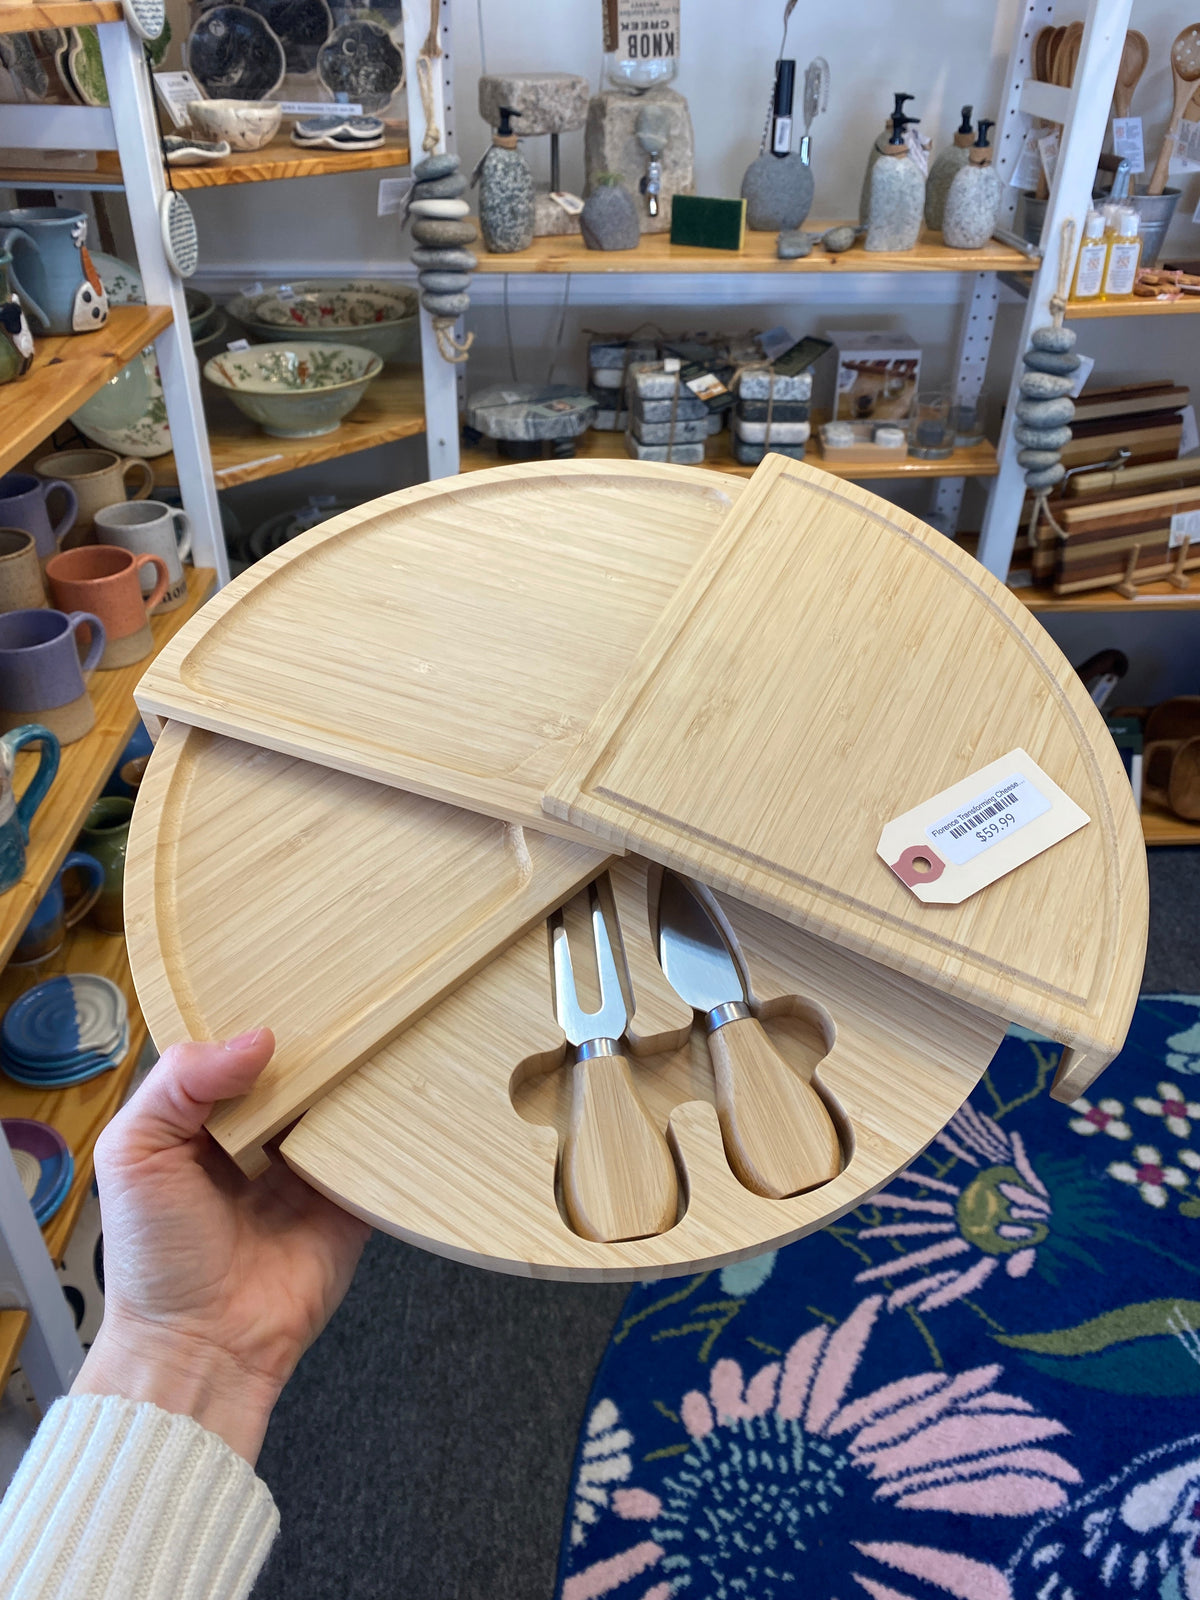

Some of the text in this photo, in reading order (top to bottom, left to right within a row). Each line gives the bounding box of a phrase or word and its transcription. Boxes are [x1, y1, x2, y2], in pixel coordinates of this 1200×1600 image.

[621, 20, 669, 32] CREEK
[628, 33, 674, 58] KNOB
[931, 818, 960, 838] Florence
[956, 796, 998, 821] Transforming
[975, 813, 1016, 842] $59.99
